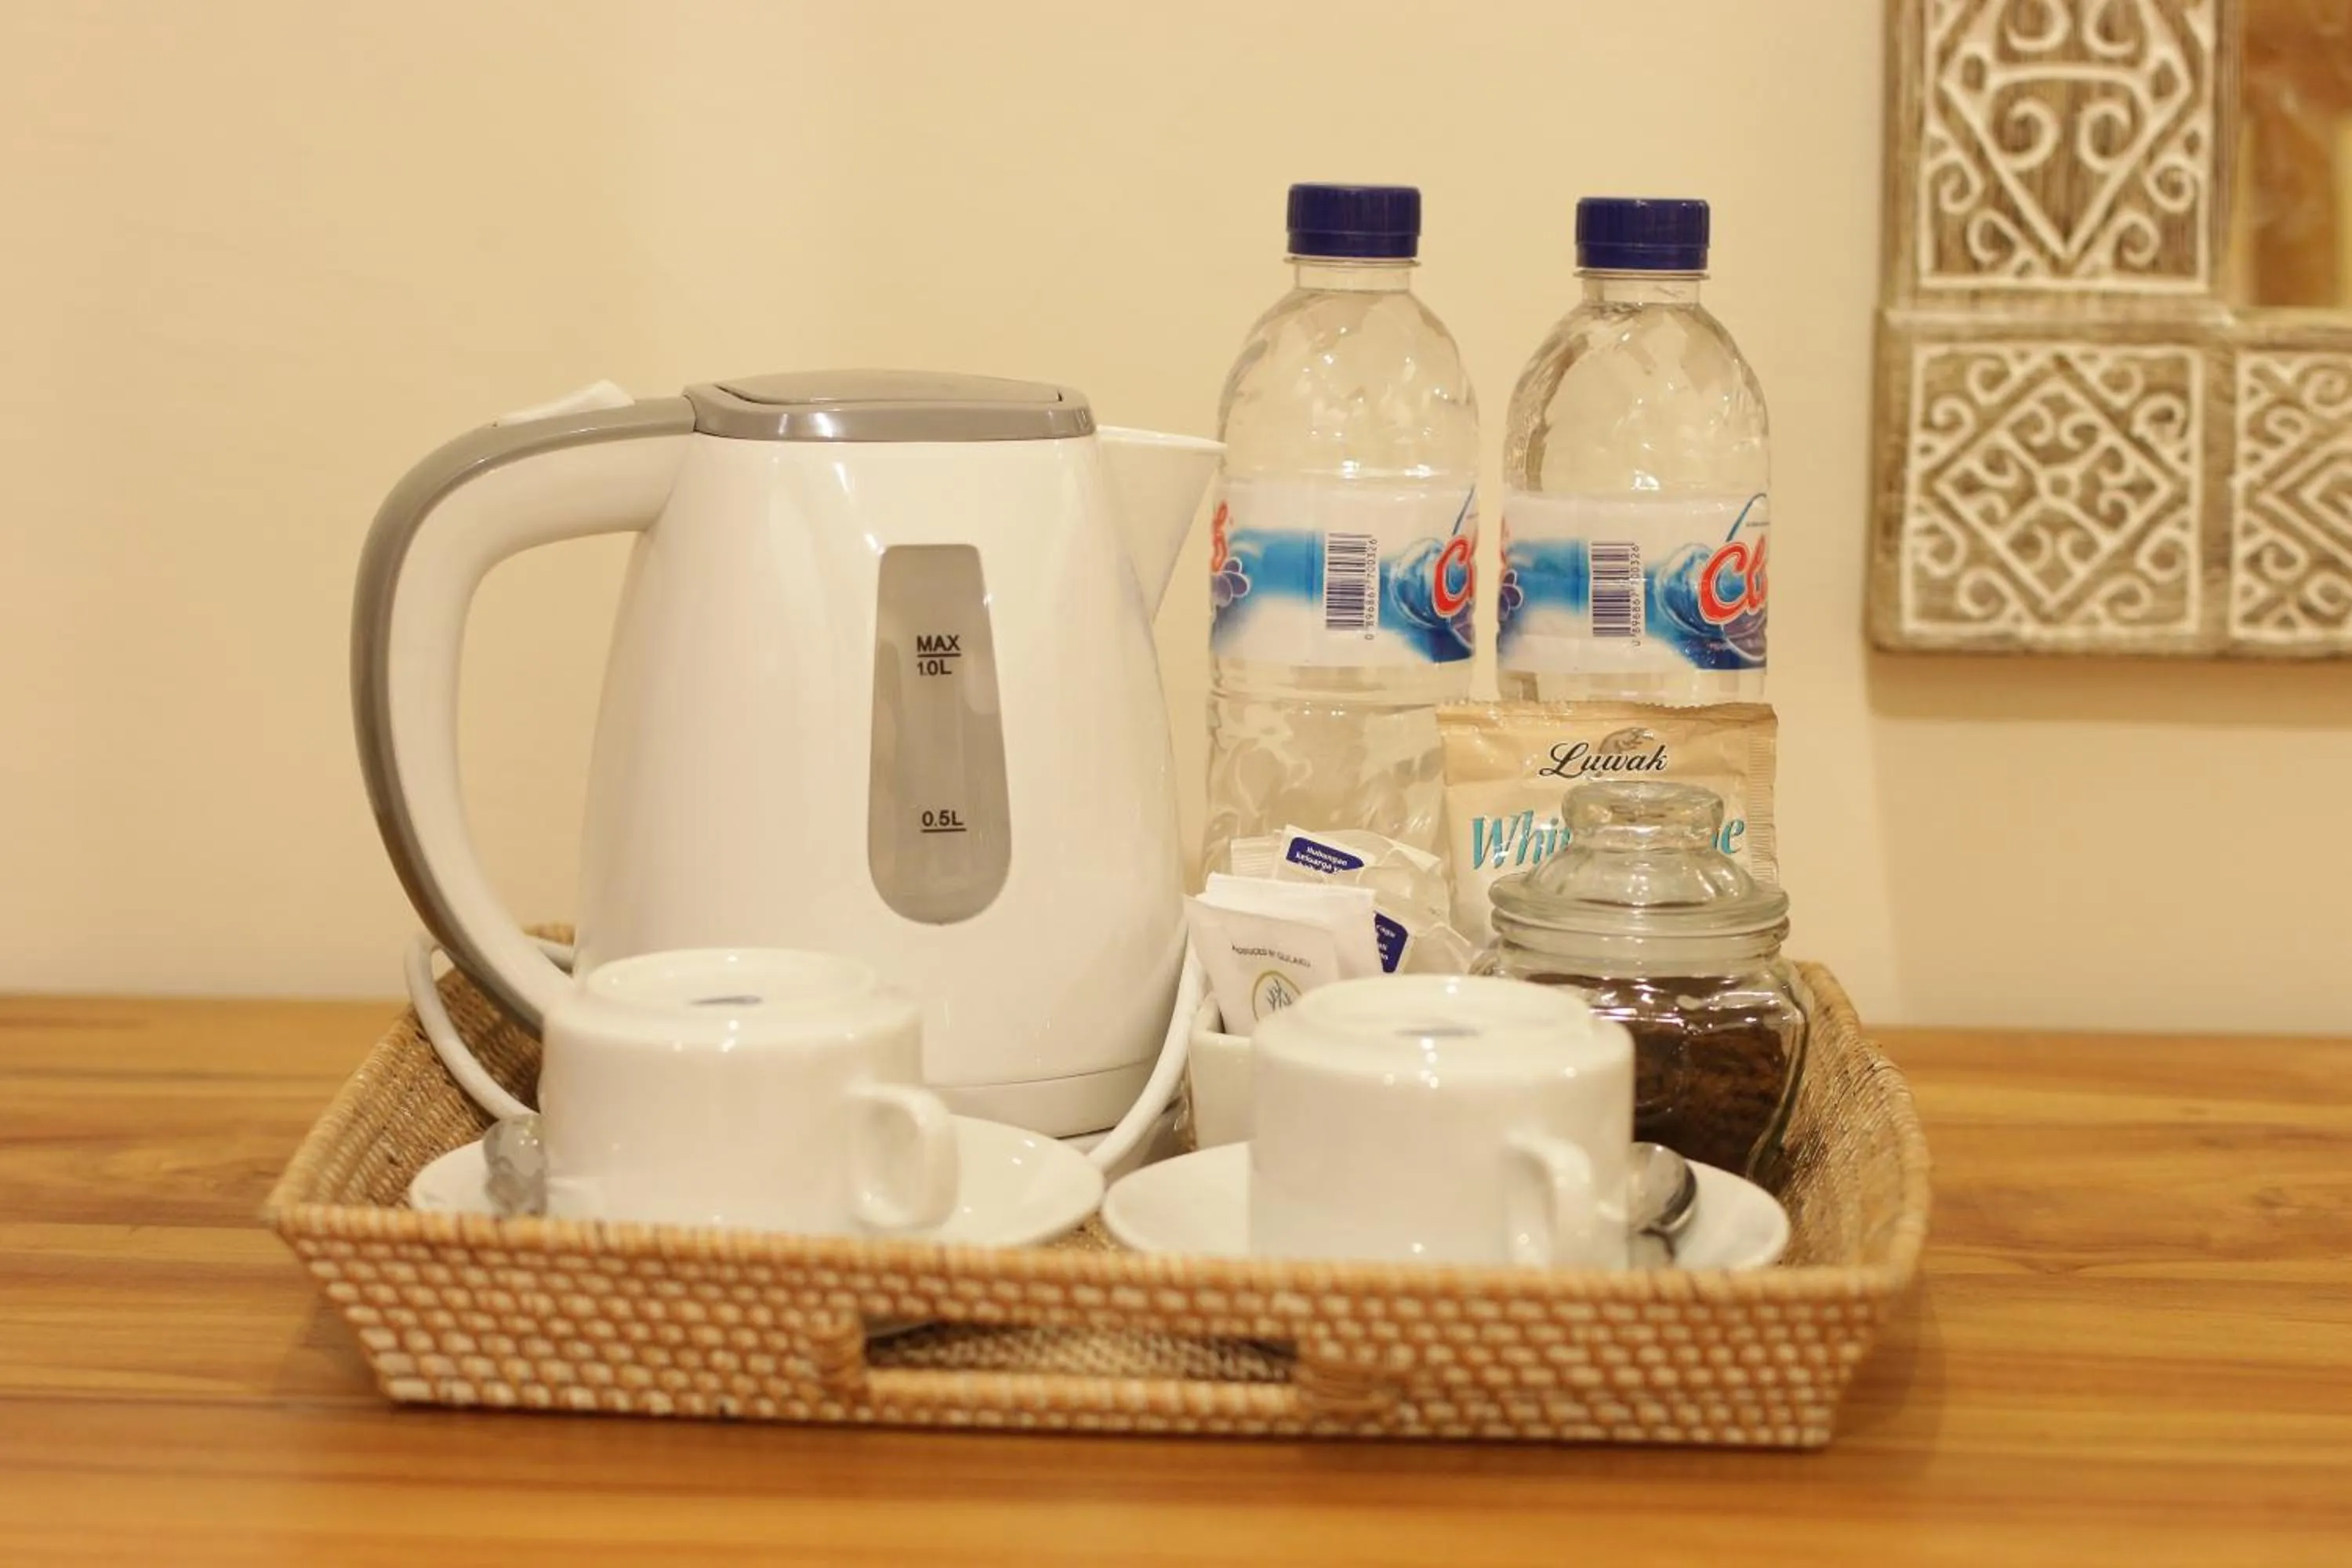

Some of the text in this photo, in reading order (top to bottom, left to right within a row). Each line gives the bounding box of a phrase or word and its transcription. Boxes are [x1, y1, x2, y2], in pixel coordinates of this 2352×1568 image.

[916, 634, 960, 652] MAX
[1539, 742, 1668, 779] Luwak
[921, 809, 964, 827] 0.5L
